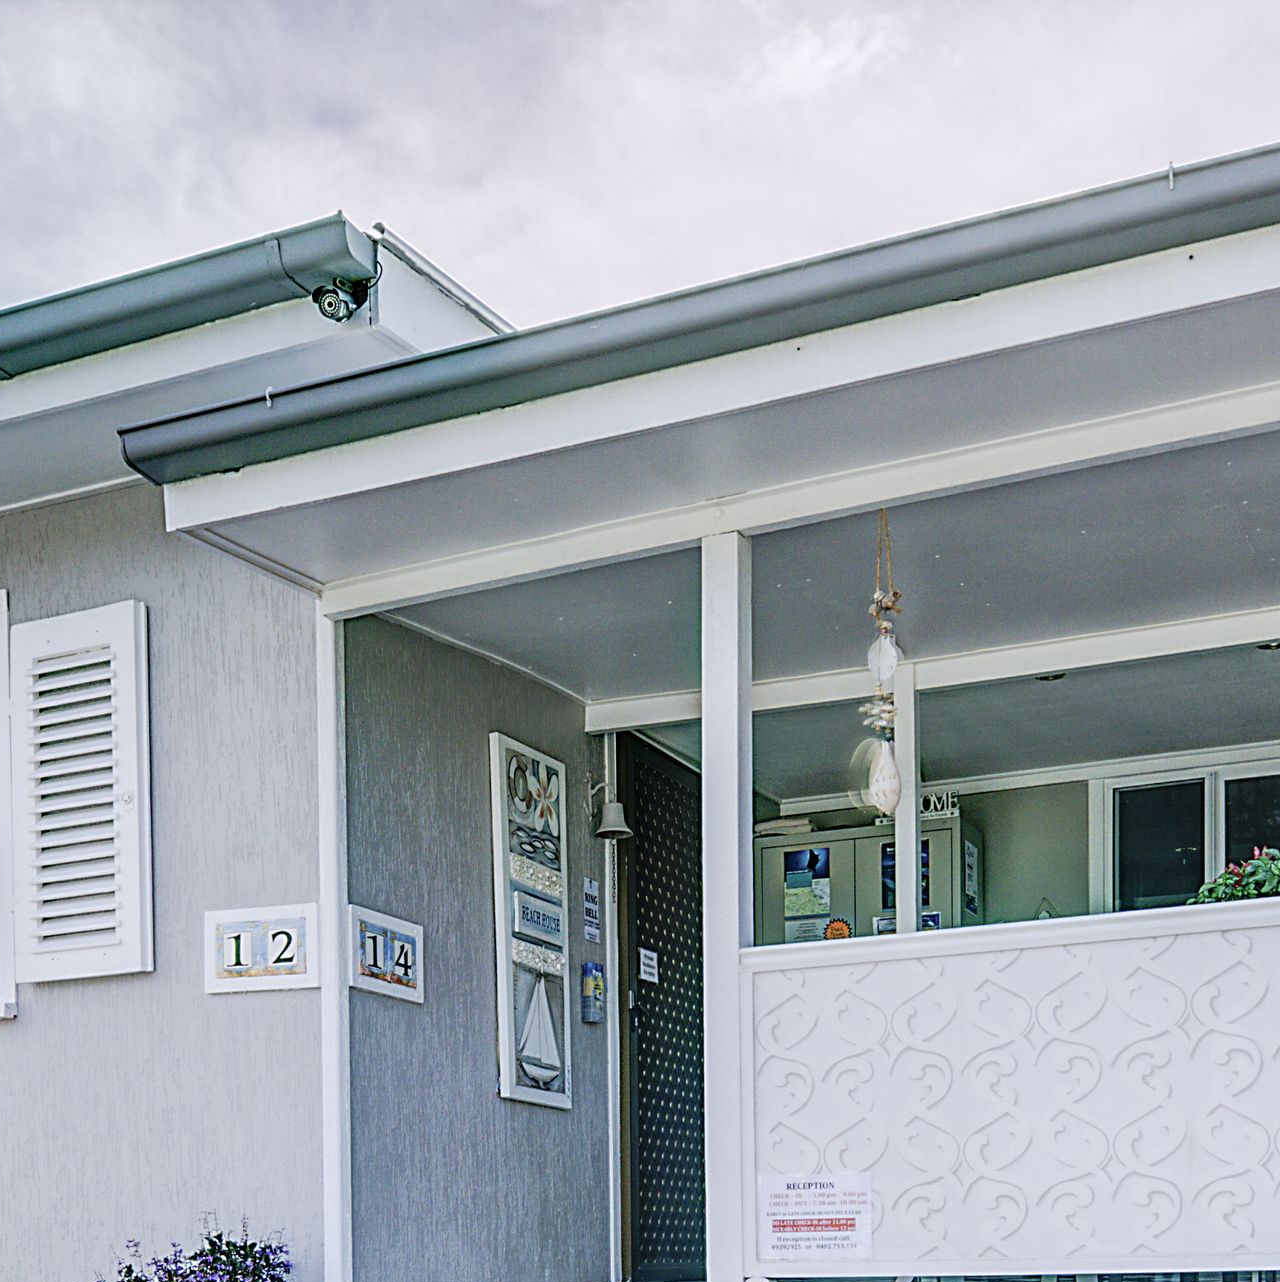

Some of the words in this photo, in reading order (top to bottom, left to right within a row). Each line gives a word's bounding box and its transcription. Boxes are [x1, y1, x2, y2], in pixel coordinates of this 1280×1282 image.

[584, 892, 598, 906] RING
[522, 905, 541, 925] BEACH
[542, 913, 560, 932] HOUSE
[585, 907, 598, 920] BELL
[786, 1182, 835, 1190] RECEPTION
